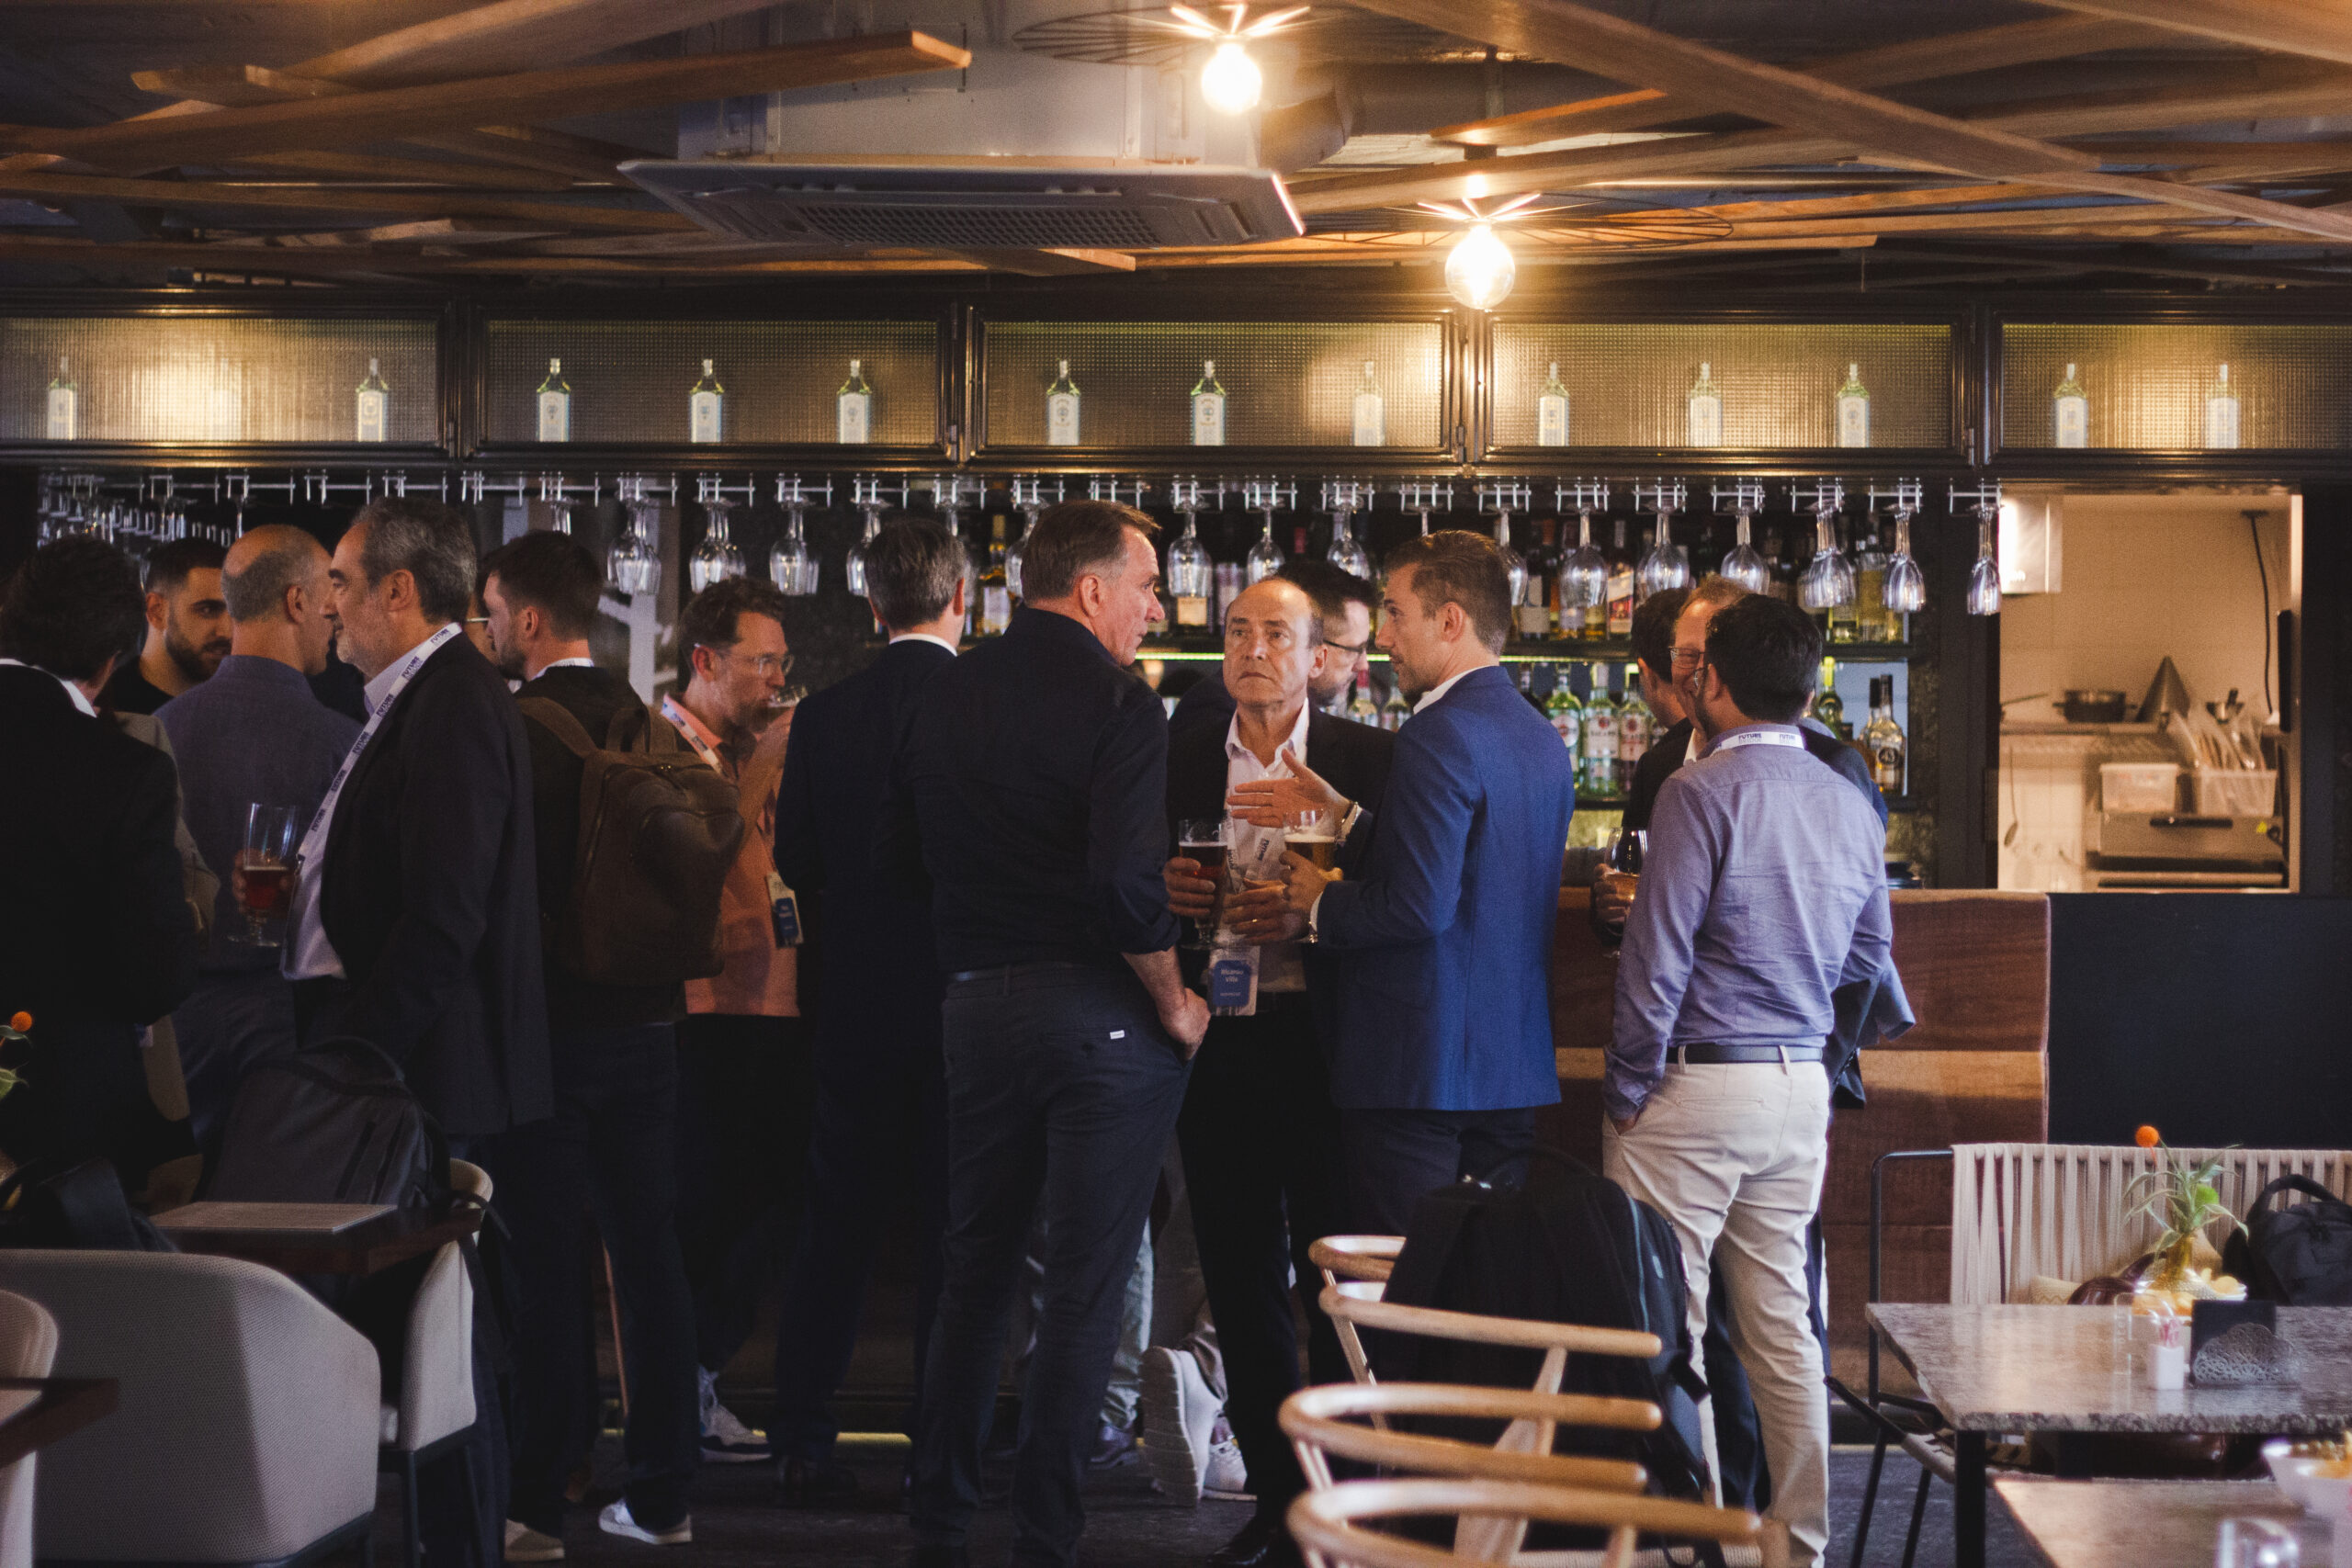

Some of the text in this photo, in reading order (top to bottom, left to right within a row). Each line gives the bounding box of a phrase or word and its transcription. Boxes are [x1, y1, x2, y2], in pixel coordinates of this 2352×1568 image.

[430, 628, 449, 644] FUTURE
[401, 656, 420, 678] FUTURE
[376, 694, 394, 717] FUTURE
[352, 731, 370, 754] FUTURE
